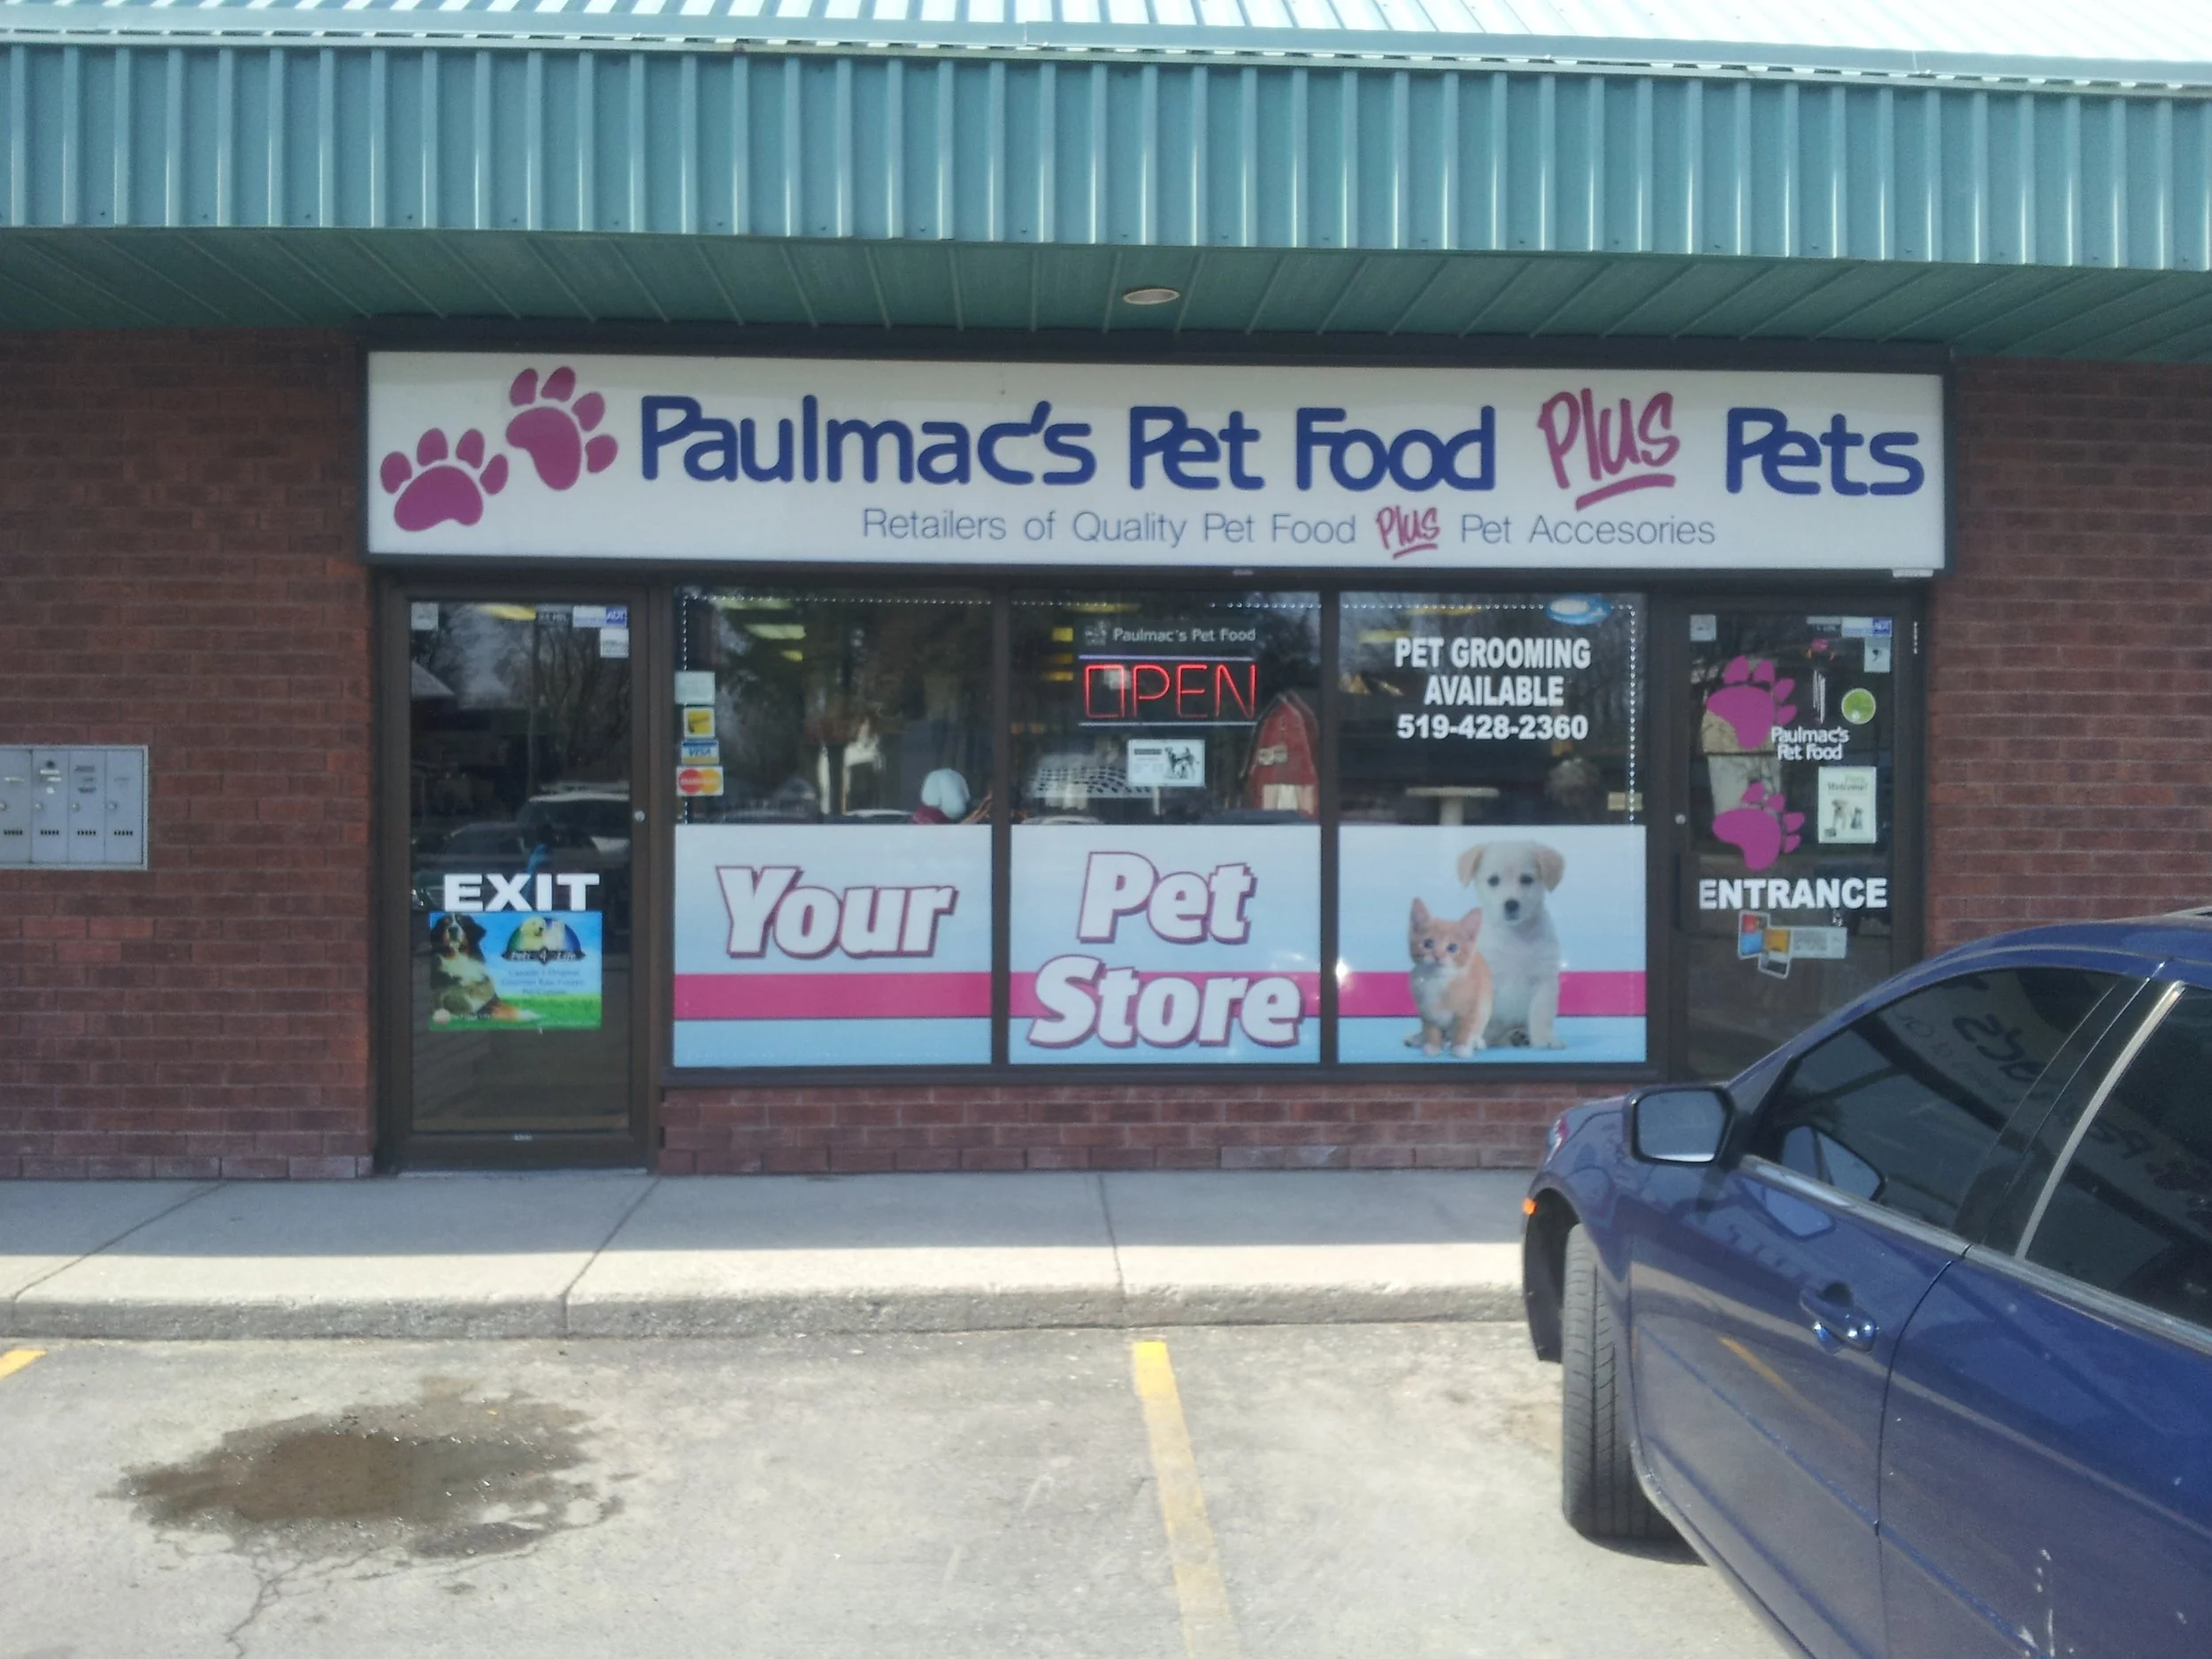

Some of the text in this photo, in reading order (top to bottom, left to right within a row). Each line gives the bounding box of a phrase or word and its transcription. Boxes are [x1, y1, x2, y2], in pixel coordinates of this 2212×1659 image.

[641, 396, 1097, 486] Paulmac's
[1130, 406, 1266, 491] Pet
[1296, 405, 1497, 493] Food
[1726, 407, 1926, 496] Pets
[863, 508, 1007, 541] Retailers
[1025, 510, 1056, 541] of
[1072, 511, 1187, 549] Quality
[1203, 512, 1254, 542] Pet
[1272, 513, 1356, 544] Food
[1462, 514, 1512, 543] Pet
[1529, 514, 1716, 545] Accesories
[1112, 627, 1256, 642] Paulmac's Pet Food
[1394, 637, 1592, 670] PET GROOMING
[1084, 664, 1257, 718] OPEN
[1424, 675, 1565, 707] AVAILABLE
[1396, 714, 1589, 741] 519-428-2360
[1770, 726, 1850, 745] Paulmac's
[1777, 744, 1843, 762] Pet Food
[444, 873, 601, 911] EXIT
[1076, 850, 1257, 944] Pet
[1699, 878, 1889, 910] ENTRANCE
[715, 864, 960, 960] Your
[1026, 953, 1304, 1048] Store
